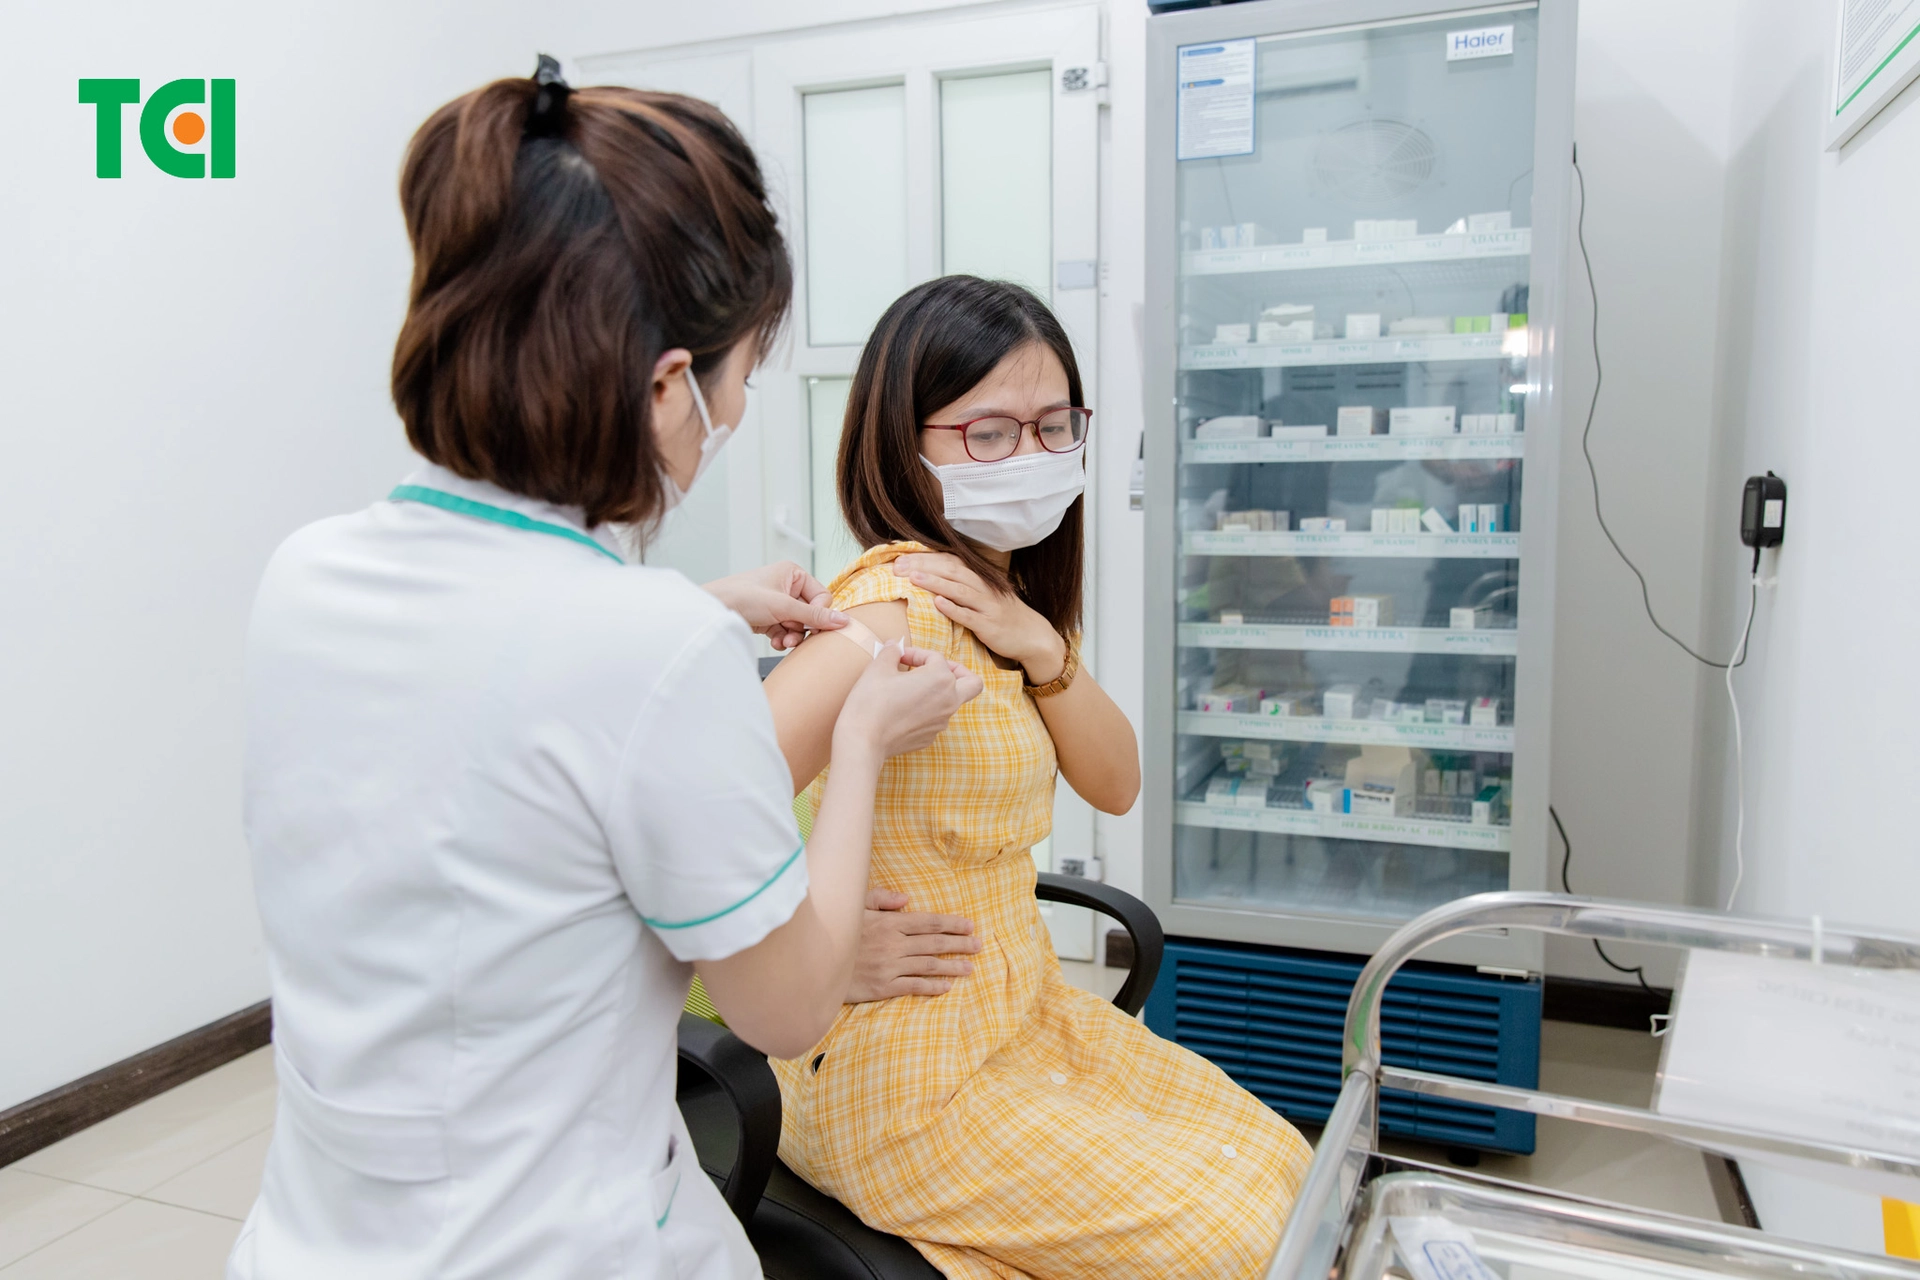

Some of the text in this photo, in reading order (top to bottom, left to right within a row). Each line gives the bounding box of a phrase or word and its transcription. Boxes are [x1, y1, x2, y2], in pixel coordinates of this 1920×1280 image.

[1455, 31, 1505, 51] Haier
[1470, 231, 1520, 246] ADACEL
[1305, 628, 1405, 640] INFLUVAC TETRA
